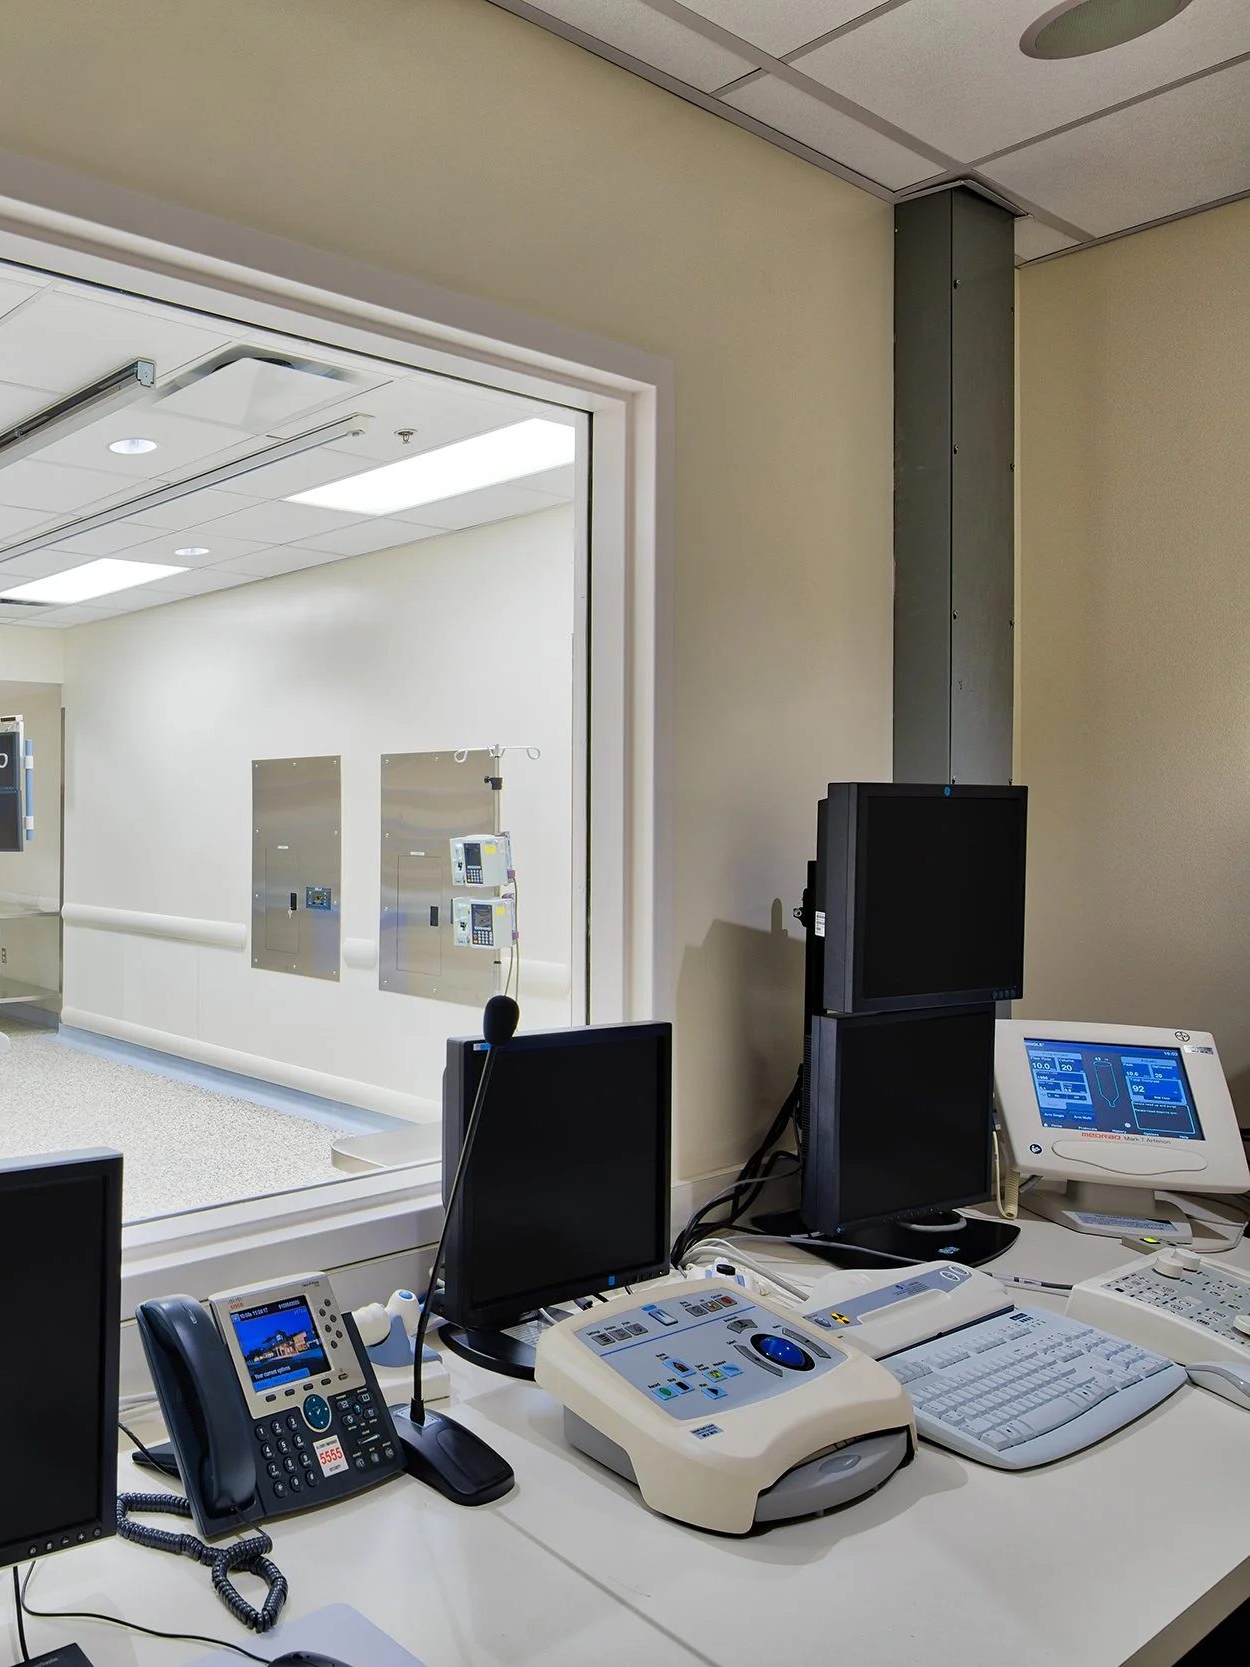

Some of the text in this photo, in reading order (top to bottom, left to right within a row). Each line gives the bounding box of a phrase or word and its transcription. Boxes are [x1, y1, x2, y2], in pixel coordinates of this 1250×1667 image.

[1032, 1062, 1050, 1070] 10.0
[1132, 1085, 1145, 1093] 92
[319, 1447, 343, 1465] 5555
